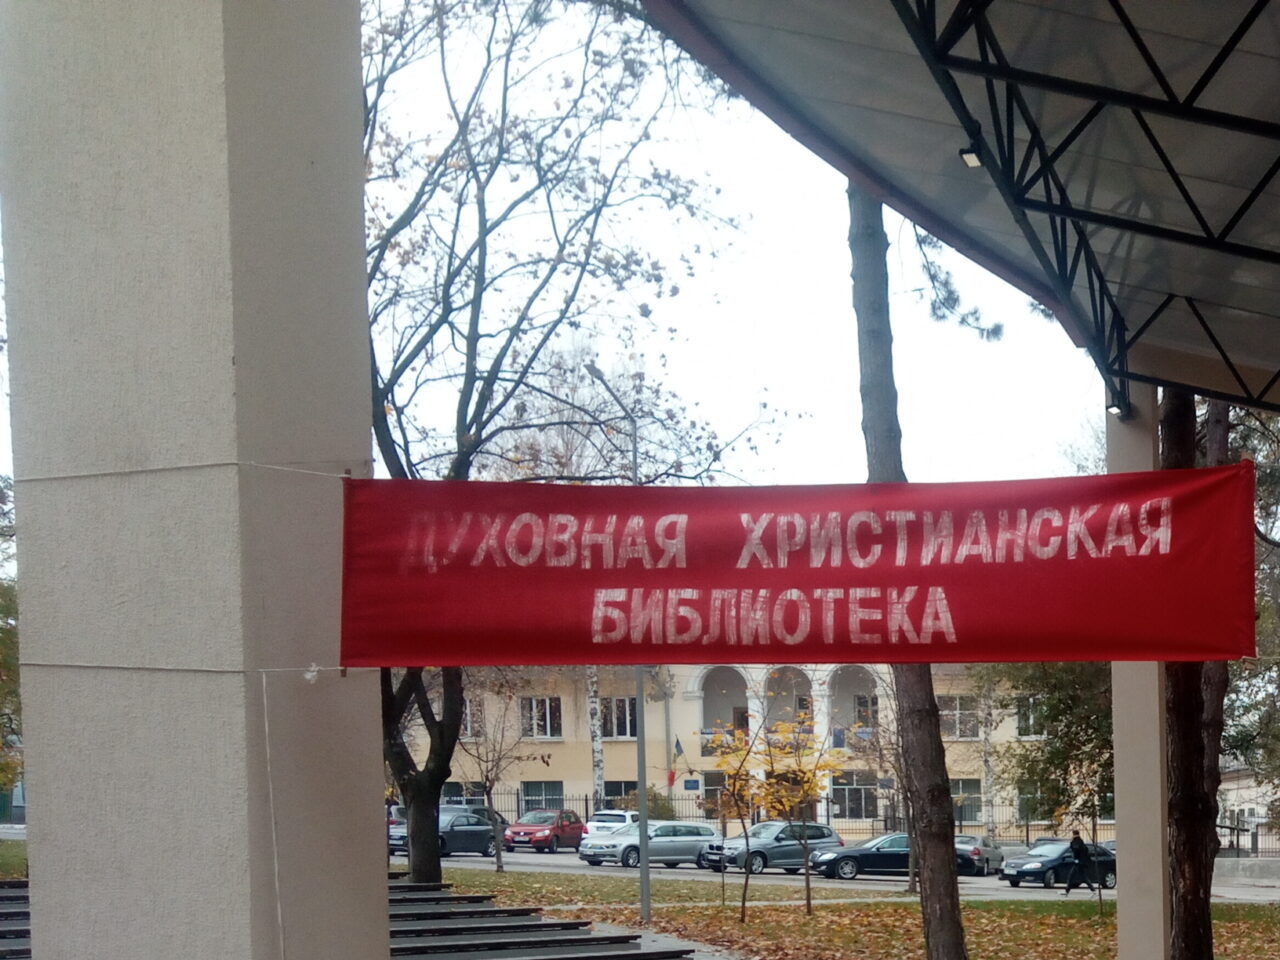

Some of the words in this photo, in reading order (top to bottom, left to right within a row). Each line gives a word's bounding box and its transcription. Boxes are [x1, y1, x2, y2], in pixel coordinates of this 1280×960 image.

[399, 512, 689, 574] ДУХОВНАЯ
[735, 497, 1174, 570] ХРИСТИАНСКАЯ
[591, 586, 958, 646] БИБЛИОТЕКА
